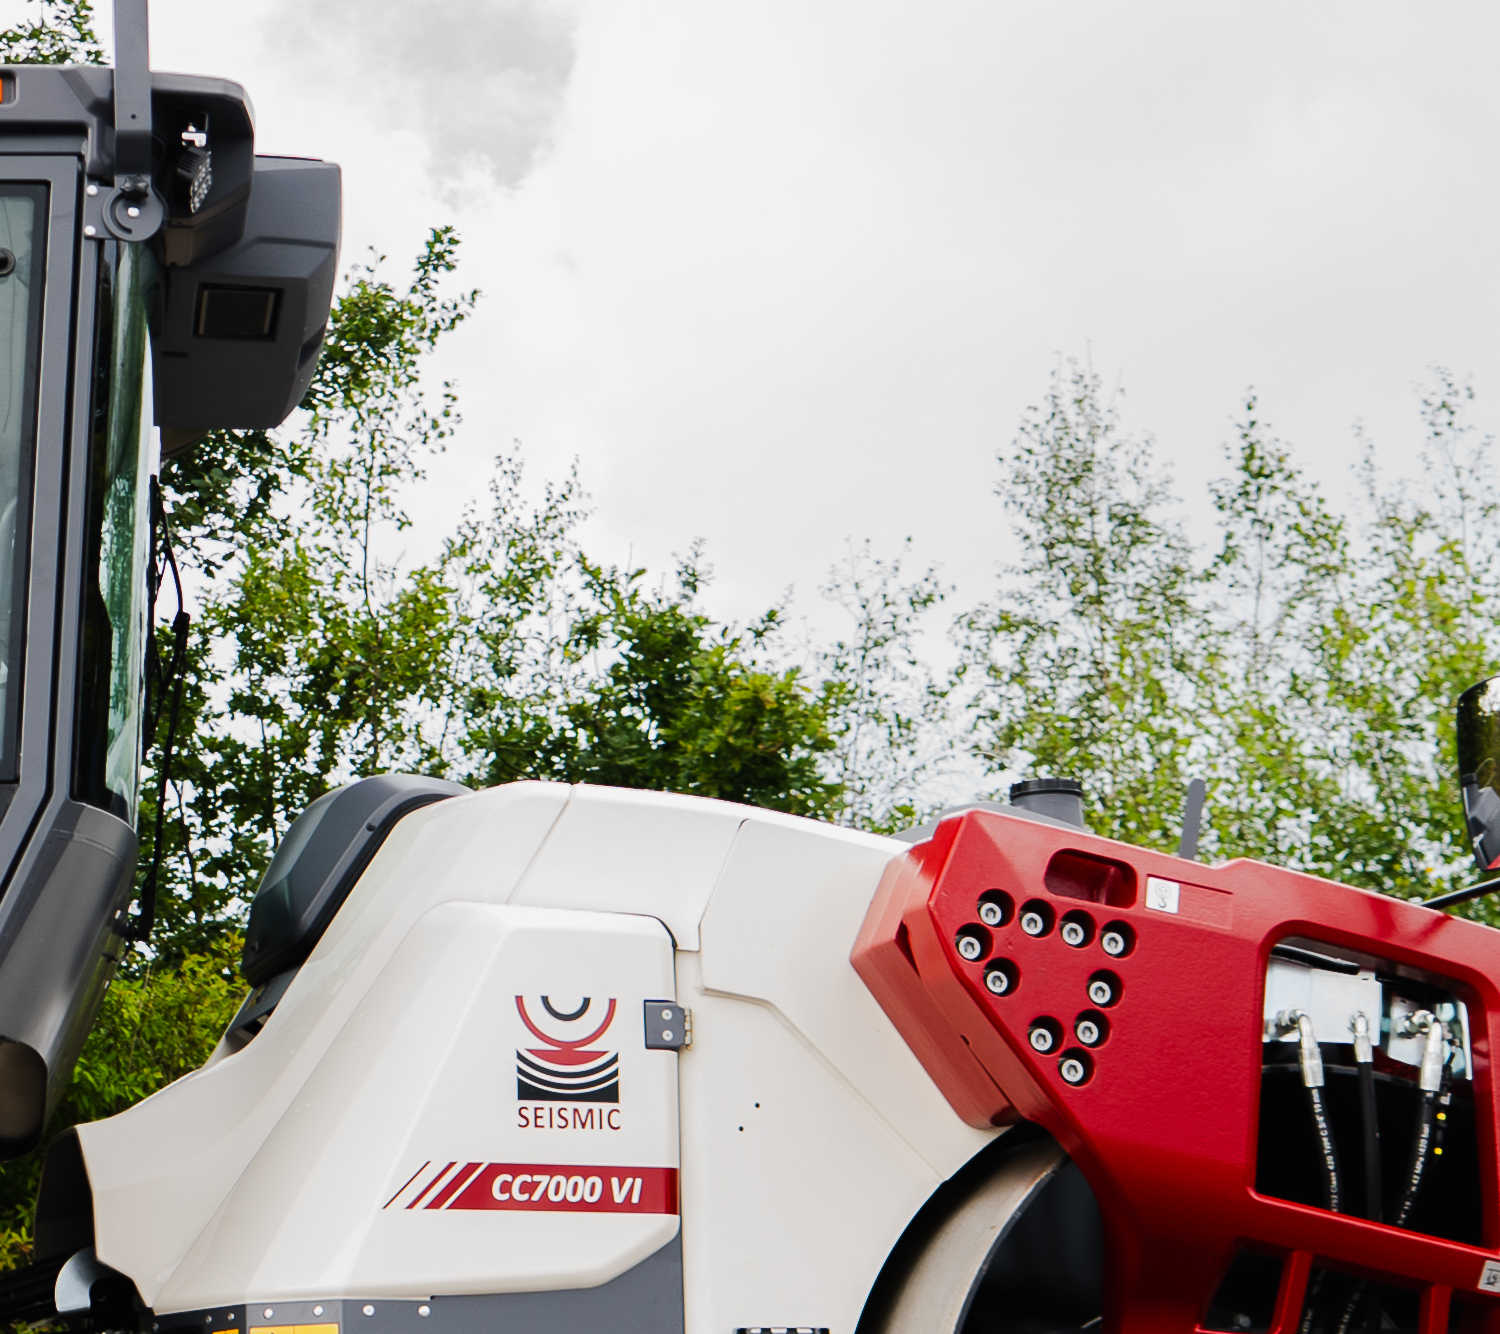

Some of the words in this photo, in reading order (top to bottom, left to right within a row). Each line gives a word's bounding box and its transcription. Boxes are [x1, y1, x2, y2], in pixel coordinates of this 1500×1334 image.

[517, 1106, 621, 1130] SEISMIC
[491, 1173, 602, 1203] CC7000
[610, 1177, 643, 1204] VI
